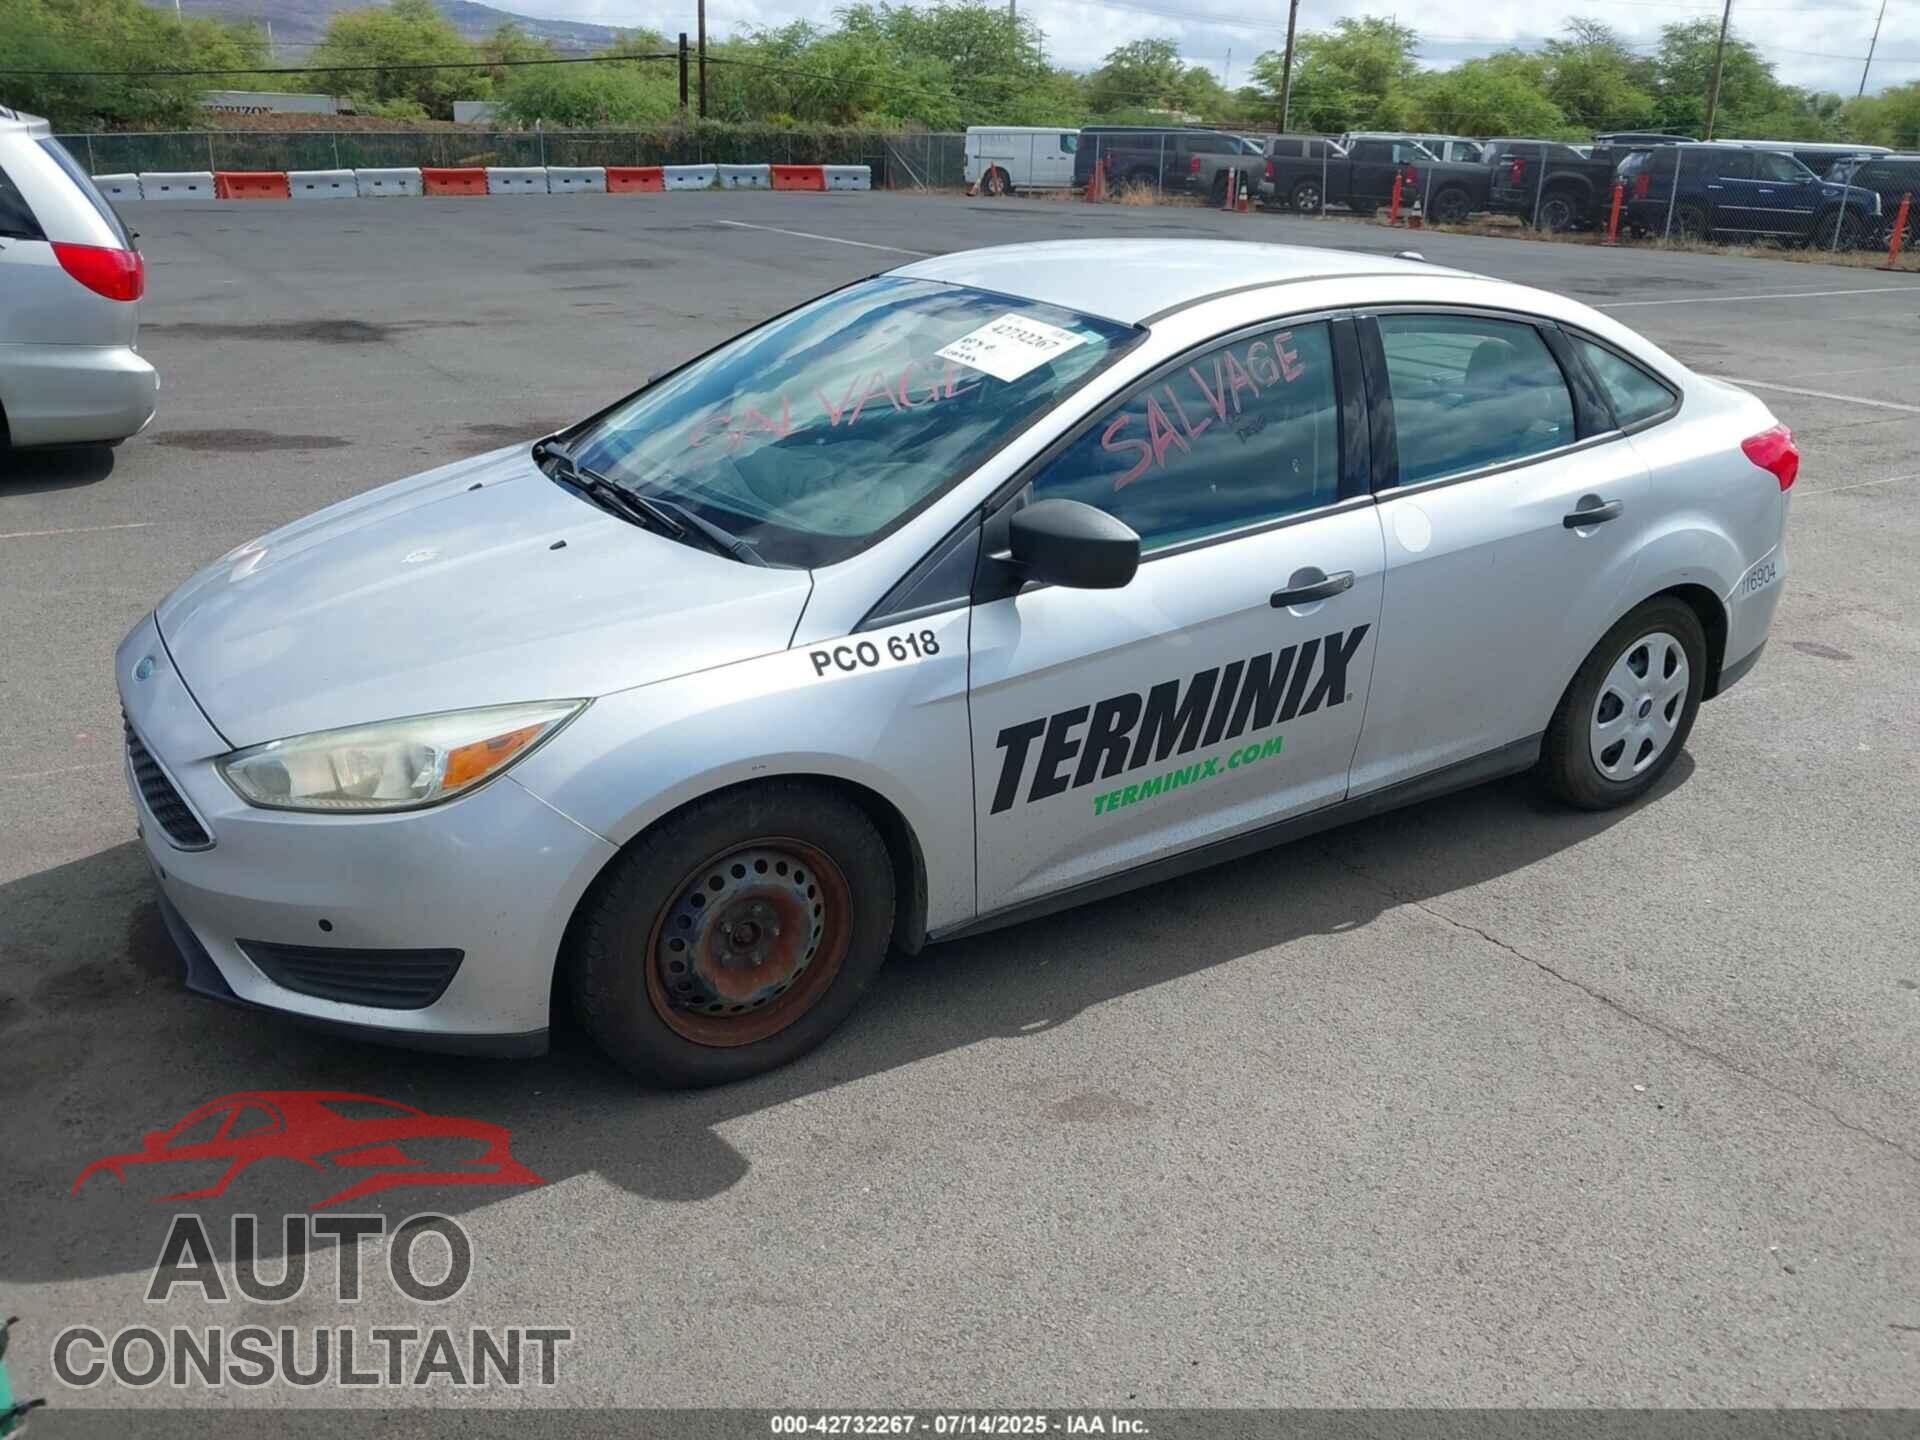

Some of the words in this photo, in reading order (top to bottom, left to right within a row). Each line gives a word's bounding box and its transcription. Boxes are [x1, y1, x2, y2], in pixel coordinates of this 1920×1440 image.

[992, 324, 1061, 350] 42732267
[1102, 331, 1305, 491] SALVAGE
[809, 641, 880, 677] PCO
[887, 629, 941, 661] 618
[990, 623, 1371, 816] TERMINIX
[1093, 735, 1285, 816] TERMINIX.COM
